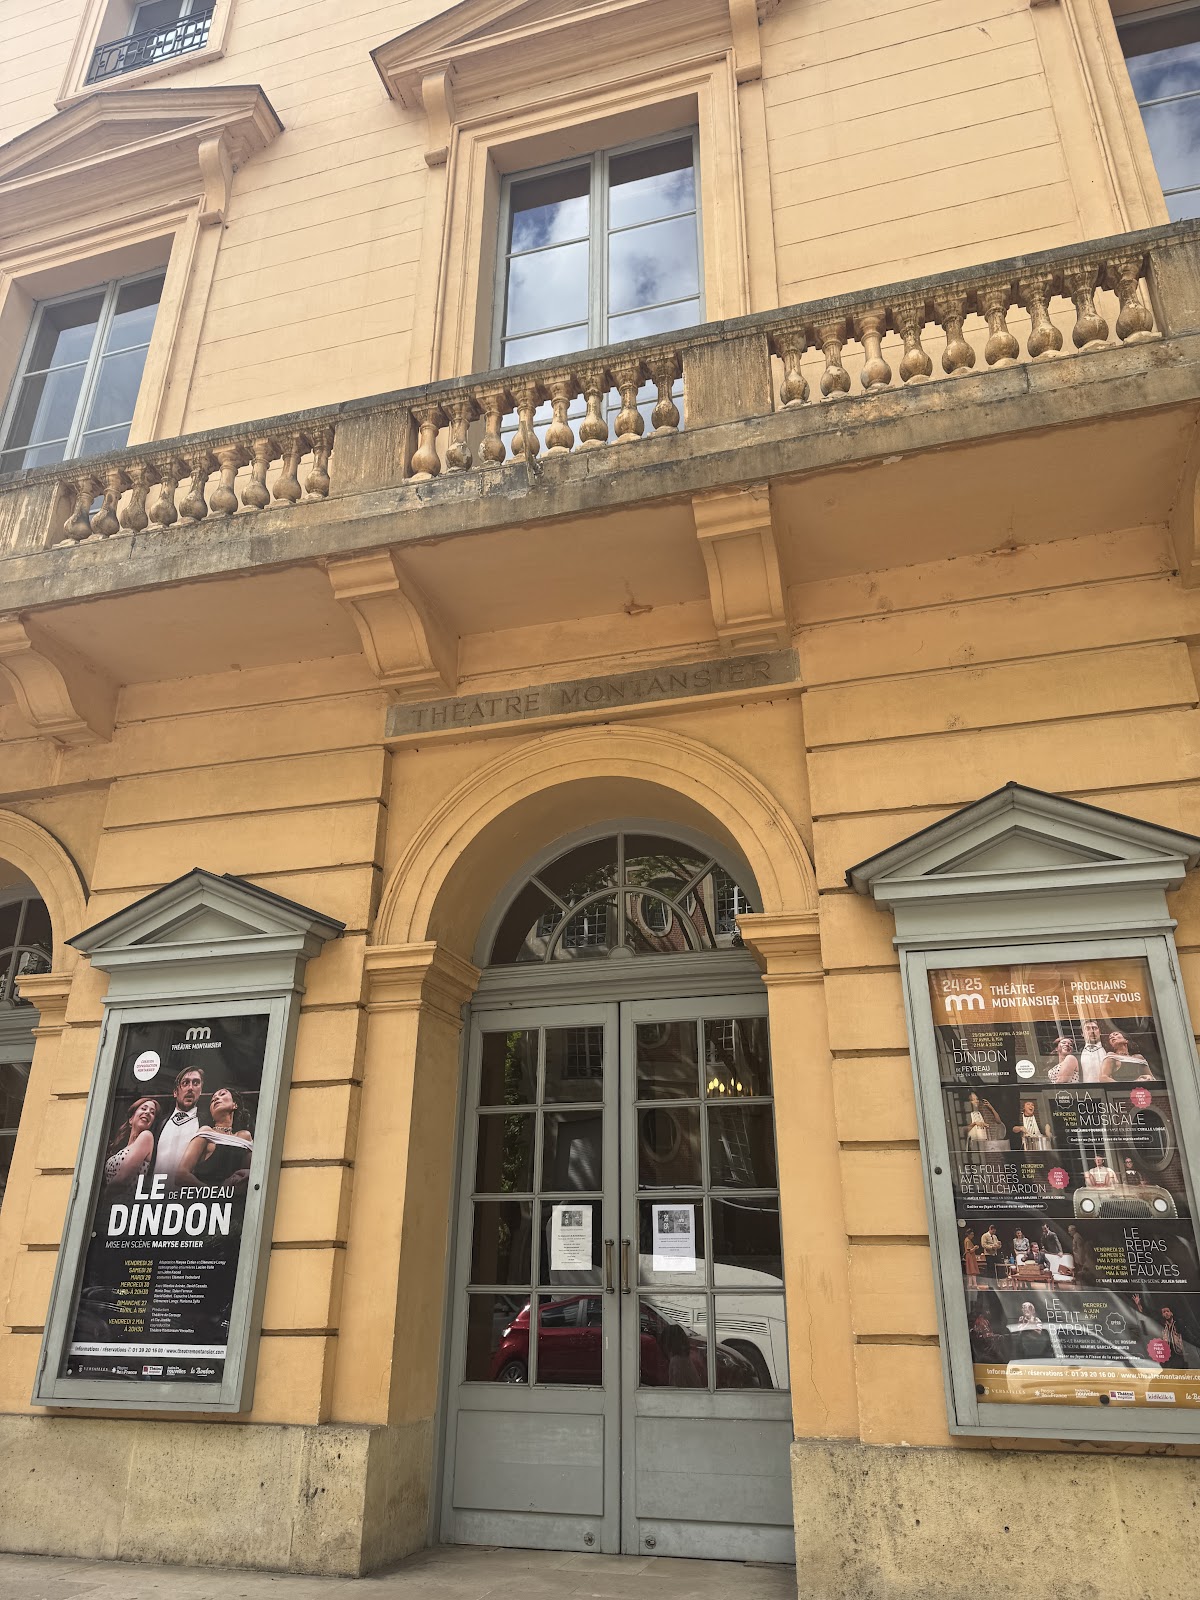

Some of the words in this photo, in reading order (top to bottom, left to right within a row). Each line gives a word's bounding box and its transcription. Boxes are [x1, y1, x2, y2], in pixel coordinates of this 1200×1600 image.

[560, 660, 773, 708] MONTANSIER
[943, 979, 960, 992] 24
[965, 977, 983, 991] 25
[990, 982, 1036, 996] THÉÂTRE
[1070, 979, 1127, 992] PROCHAINS
[992, 995, 1060, 1008] MONTANSIER
[1073, 992, 1141, 1005] RENDEZ-VOUS
[172, 1042, 192, 1051] THÉÂTRE
[192, 1041, 221, 1050] MONTANSIER
[952, 1038, 969, 1051] LE
[954, 1050, 1008, 1064] DINDON
[1076, 1091, 1093, 1103] LA
[1078, 1102, 1128, 1115] CUISINE
[1080, 1114, 1146, 1127] MUSICALE
[959, 1165, 978, 1175] LES
[980, 1163, 1017, 1174] FOLLES
[960, 1174, 1020, 1184] AVENTURES
[135, 1173, 168, 1201] LE
[168, 1190, 178, 1200] DE
[179, 1185, 235, 1200] FEYDEAU
[961, 1185, 975, 1194] DE
[996, 1184, 1046, 1194] CHARDON
[107, 1202, 233, 1237] DINDON
[1123, 1227, 1139, 1240] LE
[105, 1241, 119, 1249] MISE
[131, 1239, 150, 1248] SCÈNE
[152, 1240, 178, 1248] MARYSE
[180, 1240, 203, 1248] ESTIER
[1125, 1239, 1167, 1252] REPAS
[1127, 1251, 1154, 1264] DES
[1130, 1264, 1180, 1277] FAUVES
[1045, 1298, 1061, 1311] LE
[1047, 1310, 1081, 1323] PETIT
[1049, 1323, 1104, 1336] BARBIER
[987, 1368, 1023, 1376] Informations
